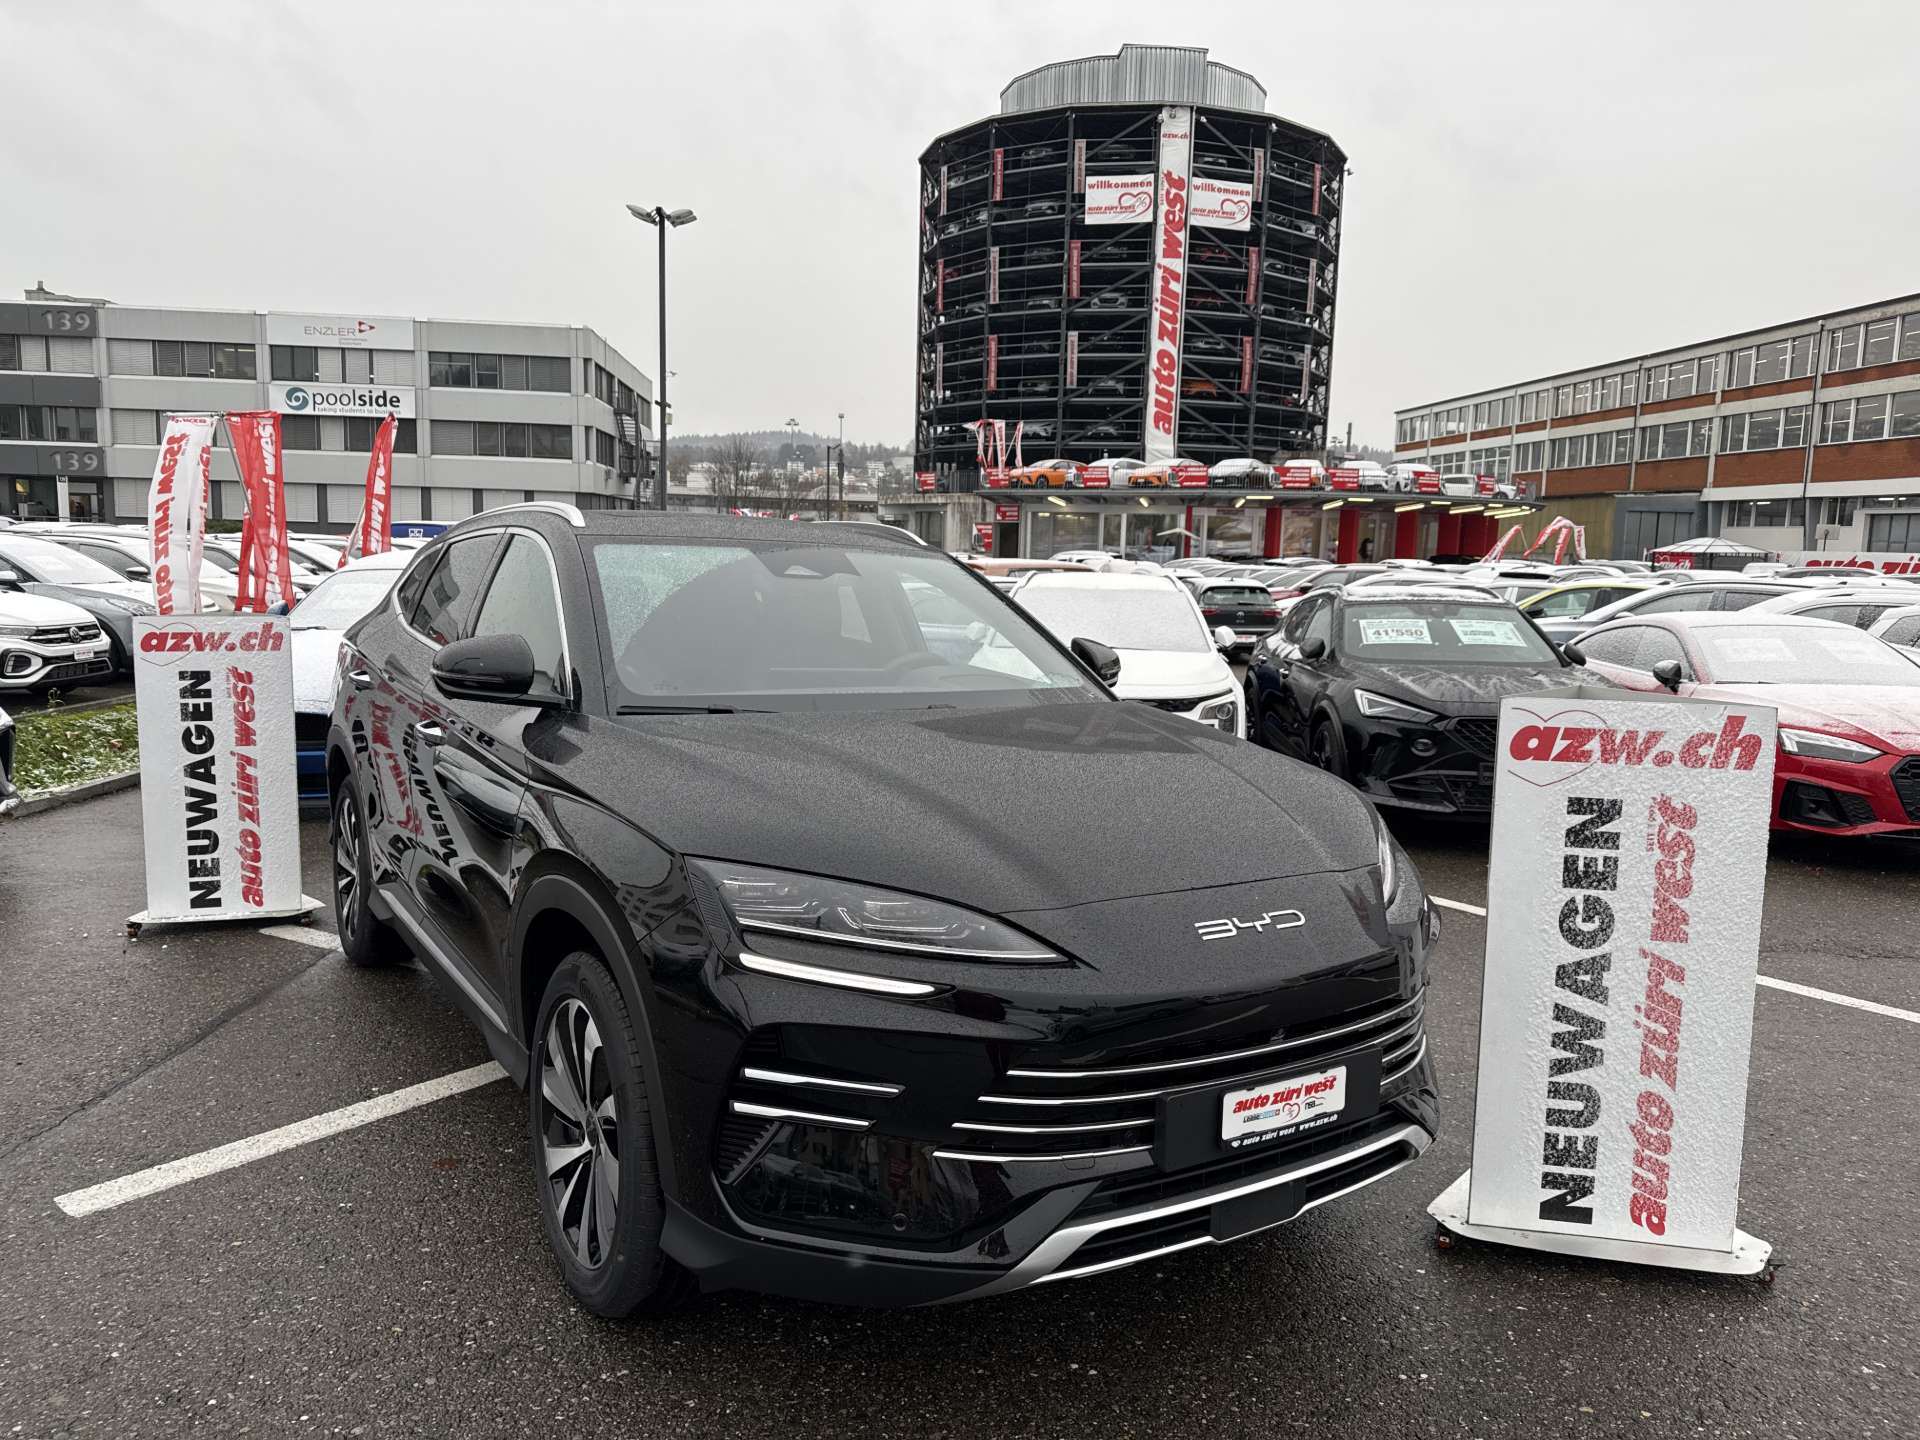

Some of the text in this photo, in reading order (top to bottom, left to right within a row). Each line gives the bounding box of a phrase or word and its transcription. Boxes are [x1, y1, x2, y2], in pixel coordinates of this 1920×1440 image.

[1088, 180, 1152, 190] willkommen
[1192, 183, 1250, 197] willkommen
[1153, 170, 1187, 435] auto züri west
[42, 311, 90, 331] 139
[304, 325, 356, 337] ENZLER
[312, 388, 400, 412] poolside
[50, 452, 98, 471] 139
[140, 622, 284, 653] azw.ch
[1508, 716, 1764, 772] azw.ch
[178, 670, 222, 909] NEUWAGEN
[229, 665, 265, 908] auto züri west
[1194, 909, 1306, 941] BYD
[1538, 796, 1624, 1225] NEUWAGEN
[1629, 793, 1698, 1236] auto züri west
[1232, 1076, 1337, 1114] auto züri west
[1279, 1126, 1296, 1137] west
